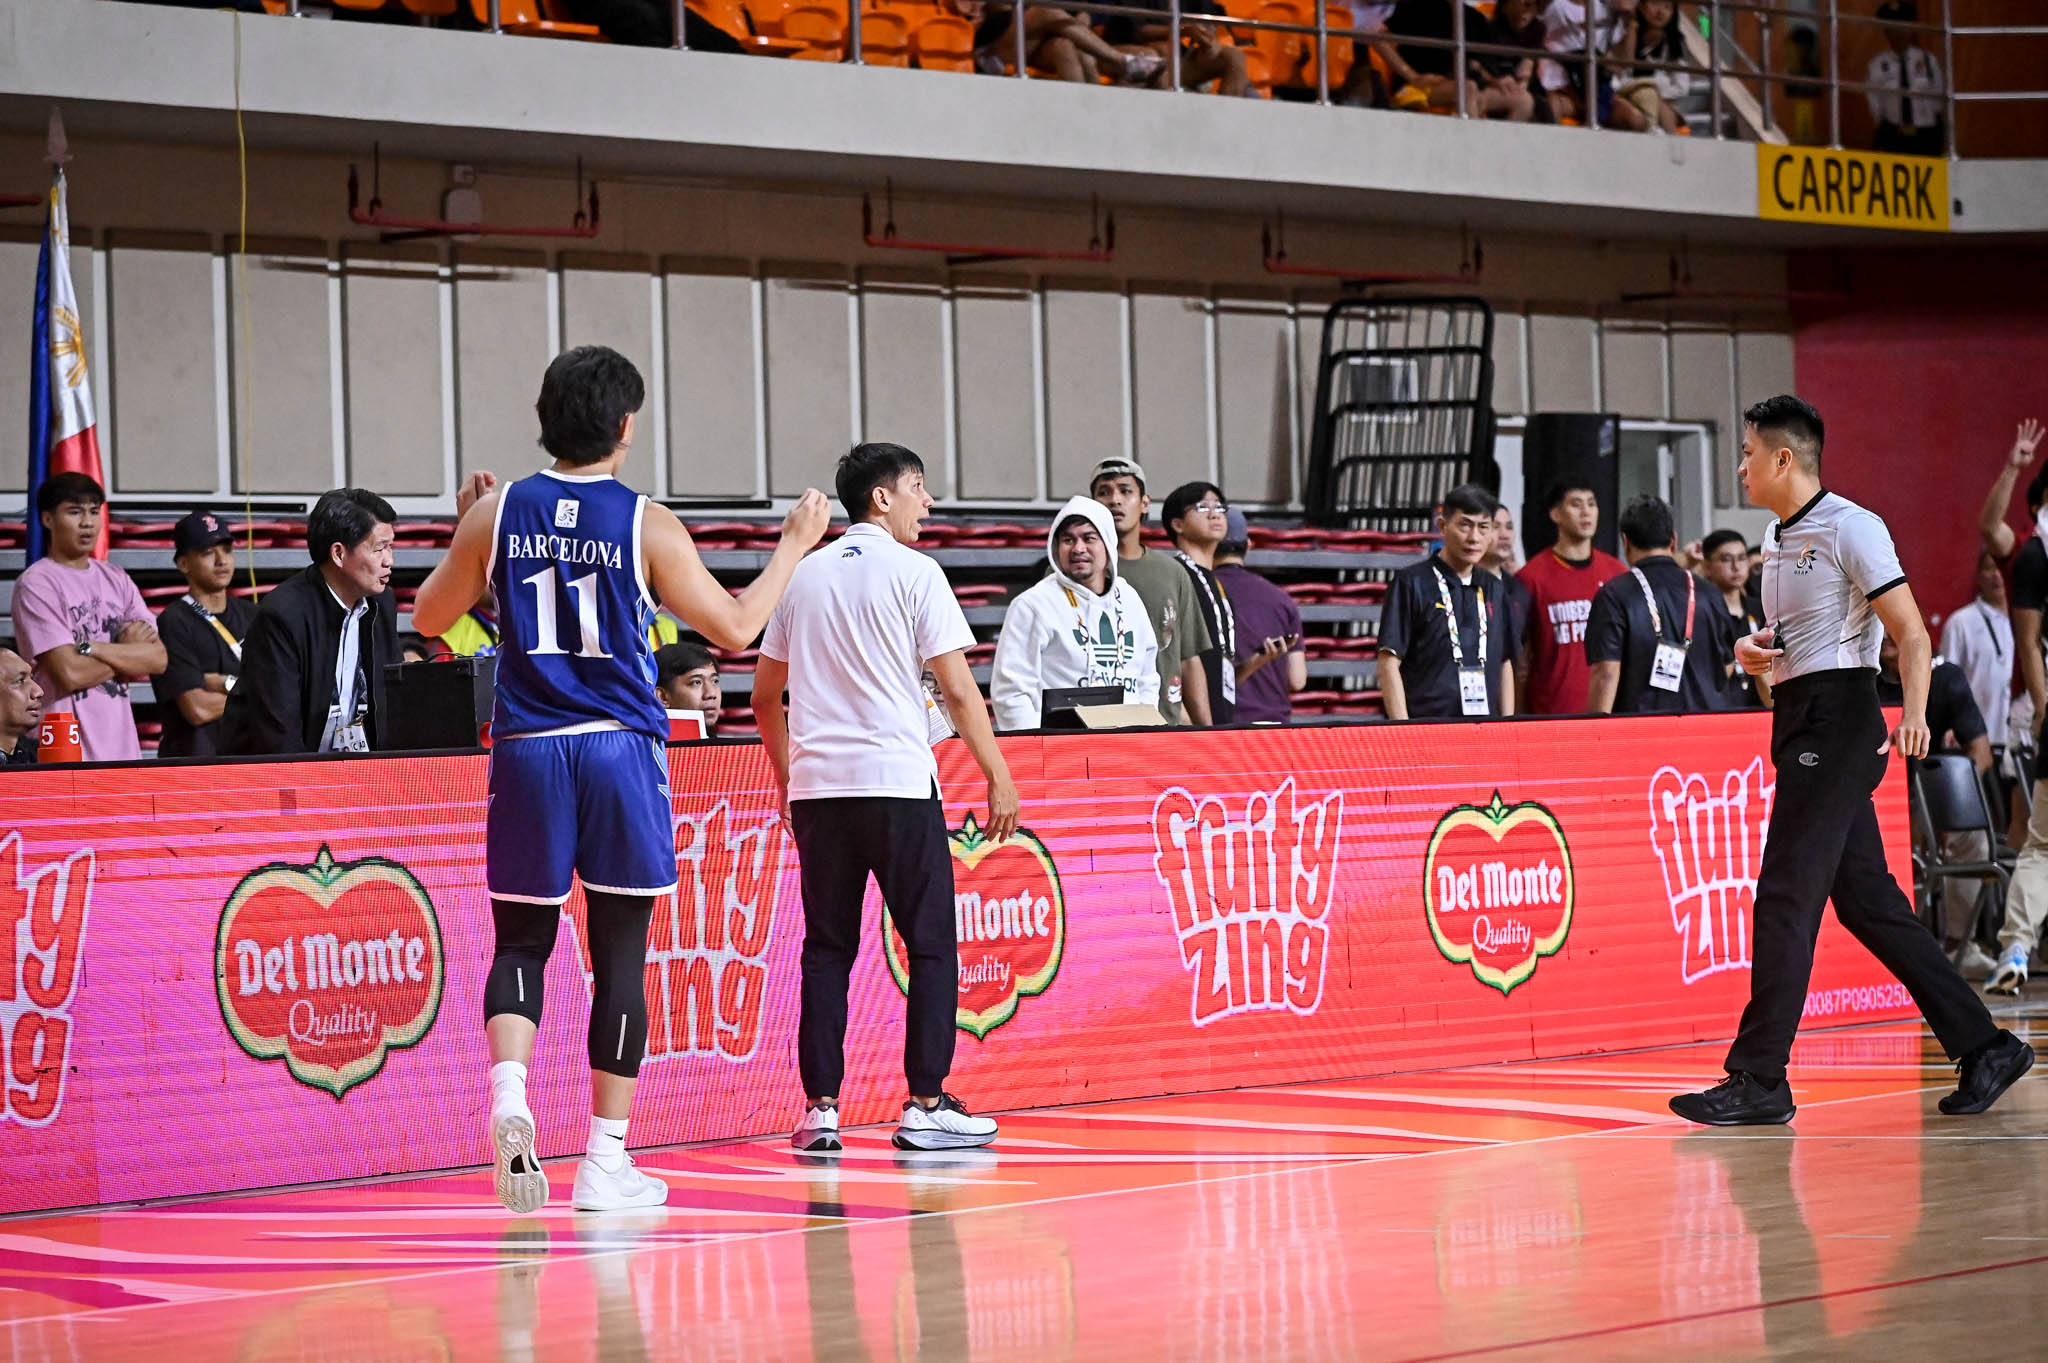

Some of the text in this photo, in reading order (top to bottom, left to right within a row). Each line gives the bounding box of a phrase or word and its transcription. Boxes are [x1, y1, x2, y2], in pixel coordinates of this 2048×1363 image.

[1774, 153, 1935, 220] CARPARK
[507, 534, 623, 569] BARCELONA
[521, 566, 614, 659] 11
[41, 725, 54, 745] 5
[69, 724, 80, 745] 5
[1153, 775, 1344, 936] fruity
[1649, 755, 1775, 905] fruit
[1437, 859, 1562, 912] Del Monte
[954, 888, 1050, 943] Monte
[1473, 915, 1531, 954] Quality
[235, 929, 425, 996] Del Monte
[957, 951, 1011, 993] uality
[289, 999, 377, 1047] Quality
